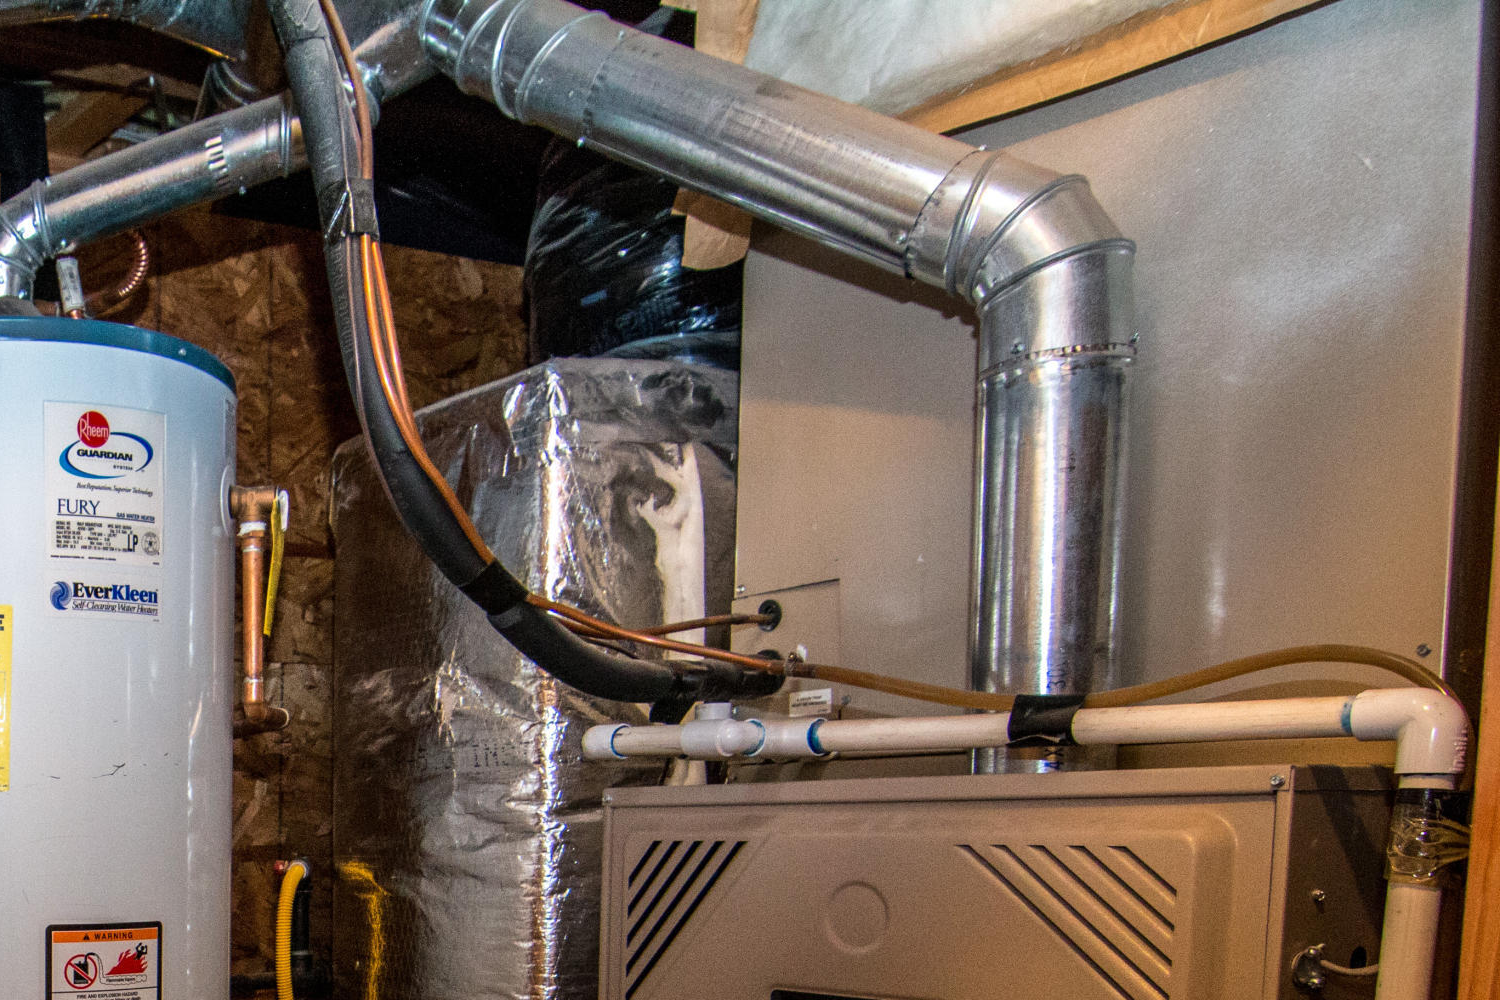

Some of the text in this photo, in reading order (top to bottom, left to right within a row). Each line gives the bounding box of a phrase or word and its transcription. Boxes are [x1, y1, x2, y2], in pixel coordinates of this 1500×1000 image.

[80, 412, 109, 440] Rheem
[77, 449, 132, 461] GUARDIAN
[57, 498, 100, 515] FURY
[127, 534, 138, 552] LP
[72, 601, 158, 616] Self-Cleaning Water Heaters
